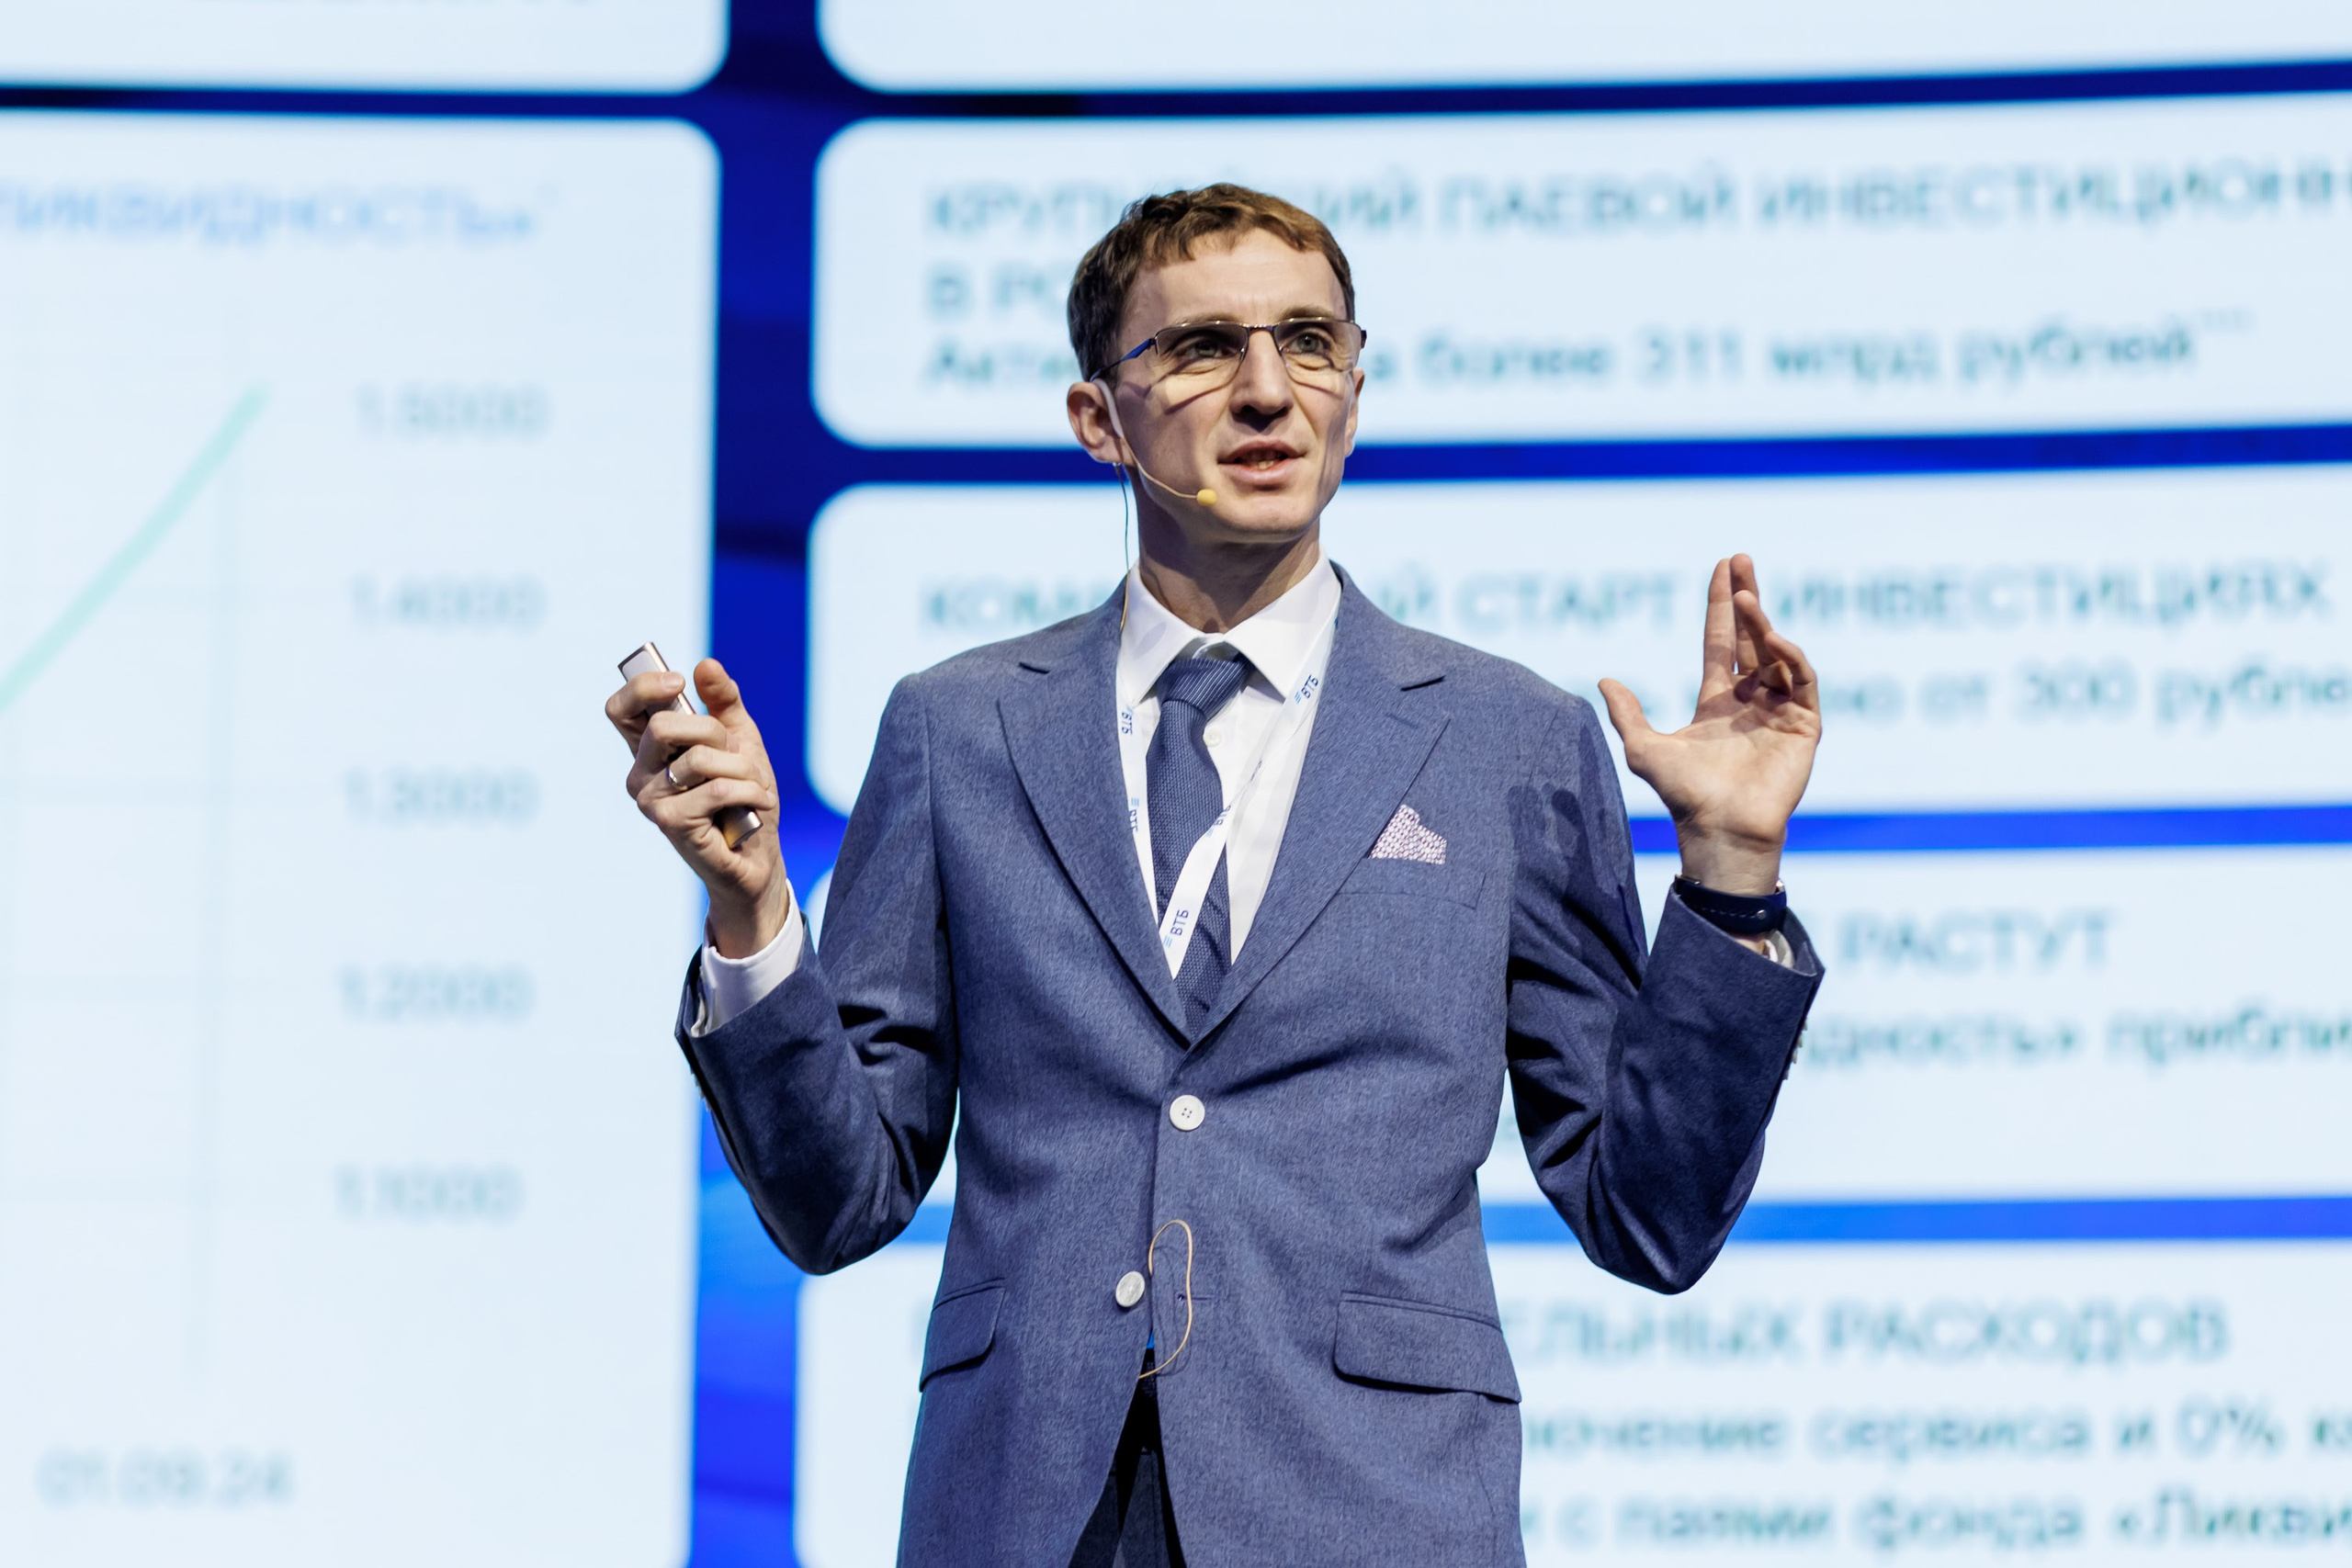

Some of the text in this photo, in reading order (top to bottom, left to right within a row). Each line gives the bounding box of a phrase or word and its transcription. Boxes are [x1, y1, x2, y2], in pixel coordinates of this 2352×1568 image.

[1637, 327, 1740, 384] 311
[1455, 573, 1679, 634] СТАРТ
[1301, 674, 1319, 699] ВТБ
[2016, 663, 2137, 724] 300
[1170, 908, 1189, 936] ВТБ
[1839, 909, 2117, 974] РАСТУТ
[1825, 1295, 2233, 1371] РАСХОДОВ
